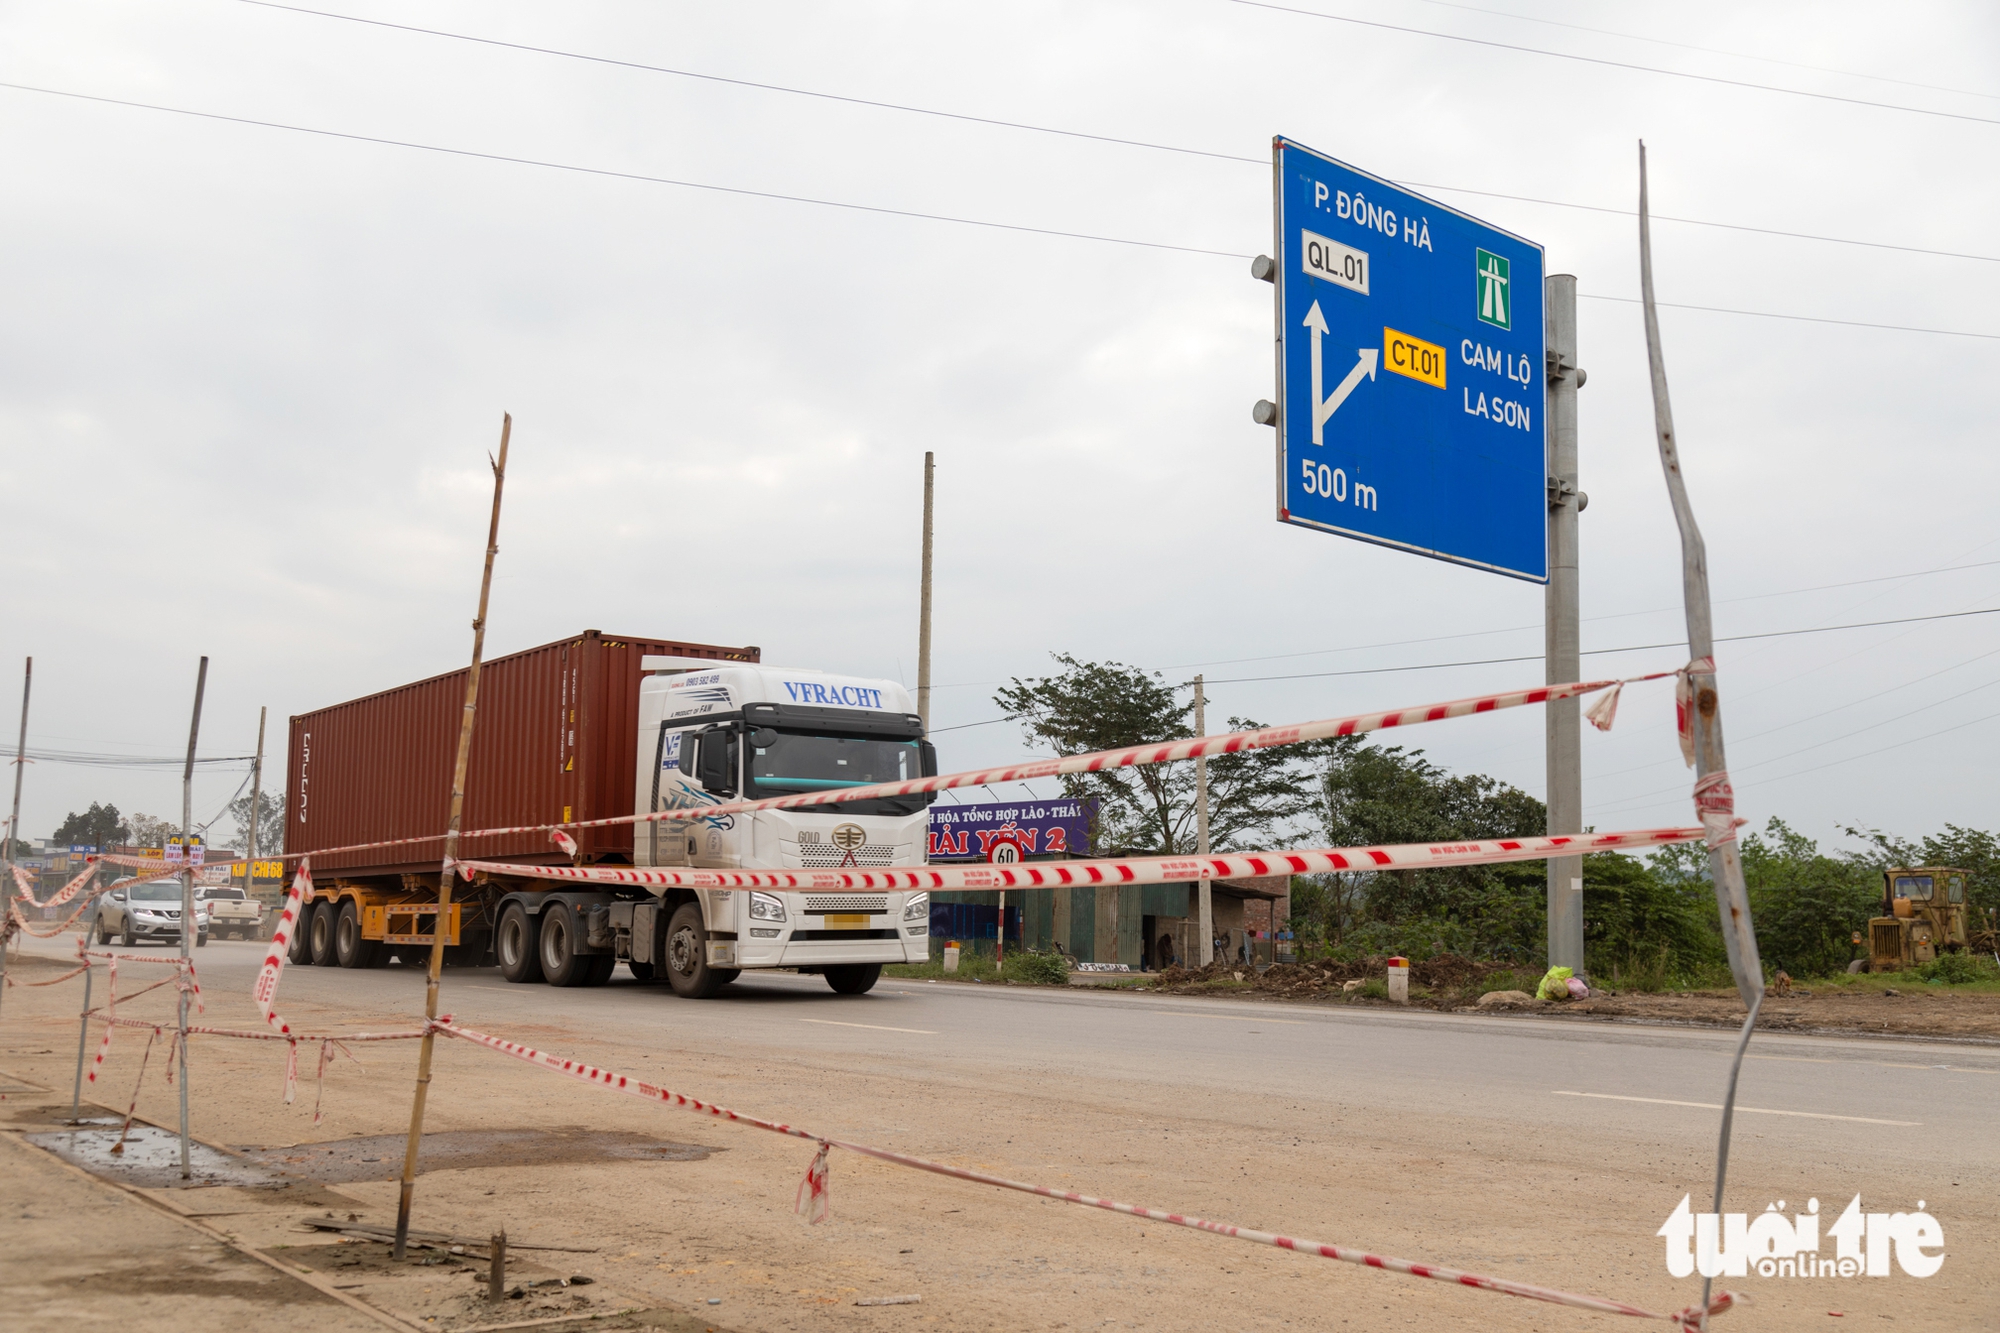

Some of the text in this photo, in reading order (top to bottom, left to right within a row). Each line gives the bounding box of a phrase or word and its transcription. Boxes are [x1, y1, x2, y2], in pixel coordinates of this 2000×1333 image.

[1336, 193, 1397, 239] ĐÔNG
[1404, 217, 1433, 253] HÀ
[1308, 241, 1364, 286] QL.01
[1392, 340, 1440, 379] CT.01
[1461, 339, 1531, 390] CAM LỘ
[1463, 387, 1530, 432] LA SƠN
[1302, 459, 1378, 511] 500 m
[686, 678, 700, 687] 0903
[783, 681, 883, 709] VFRACHT
[700, 703, 714, 713] FAW
[936, 809, 960, 824] HÓA
[962, 806, 993, 822] TỔNG
[995, 807, 1019, 823] HỢP
[798, 831, 820, 844] GOLD
[1045, 827, 1067, 852] 2
[998, 848, 1014, 864] 60
[270, 862, 283, 878] 68
